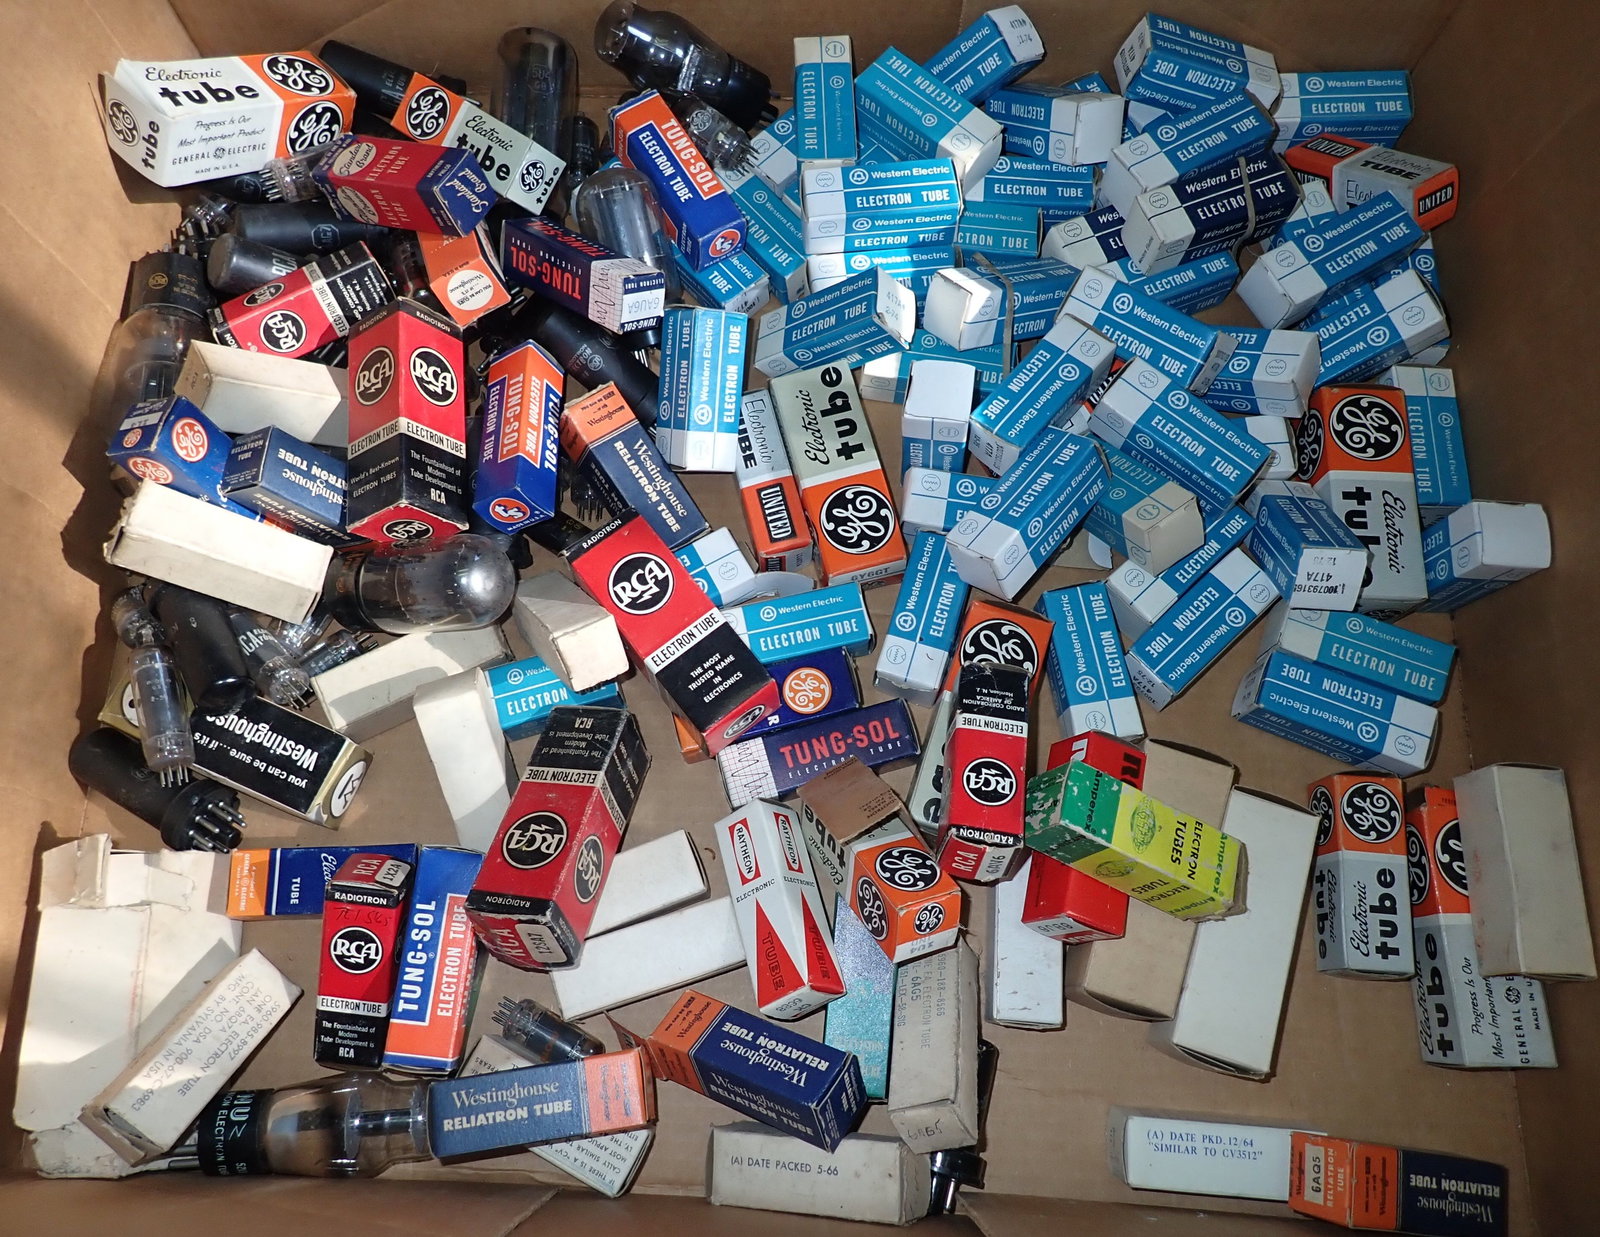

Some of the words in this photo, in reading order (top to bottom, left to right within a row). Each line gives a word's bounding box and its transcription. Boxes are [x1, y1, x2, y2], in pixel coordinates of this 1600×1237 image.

[1157, 20, 1181, 34] TUBE
[1190, 30, 1236, 51] ELECTRON
[931, 46, 960, 75] Western
[960, 26, 991, 53] Electric
[145, 67, 222, 81] Electronic
[886, 56, 912, 78] TUBE
[977, 54, 1003, 77] TUBE
[1152, 60, 1178, 82] TUBE
[159, 82, 259, 107] tube
[803, 71, 815, 119] ELECTRON
[914, 77, 963, 113] ELECTRON
[1185, 69, 1237, 92] ELECTRON
[1326, 79, 1364, 88] Western
[1366, 78, 1403, 87] Electric
[990, 100, 1006, 114] TUBE
[1011, 104, 1045, 120] ELECTRON
[1176, 109, 1208, 130] Western
[1208, 94, 1245, 116] Electric
[1311, 102, 1365, 114] ELECTRON
[1376, 101, 1403, 112] TUBE
[142, 120, 160, 169] tube
[178, 138, 197, 148] Most
[198, 131, 235, 142] Important
[237, 127, 265, 137] Product
[466, 115, 513, 151] Electronic
[805, 127, 818, 151] TUBE
[1307, 138, 1355, 157] UNITED
[172, 152, 210, 165] GENERAL
[228, 143, 266, 155] ELECTRIC
[366, 146, 402, 181] ELECTRON
[388, 156, 409, 174] TUBE
[661, 119, 714, 192] TUNG-SOL
[458, 168, 487, 192] Brand
[638, 131, 676, 176] ELECTRON
[670, 176, 693, 202] TUBE
[871, 171, 911, 179] Western
[913, 166, 950, 175] Electric
[446, 179, 488, 212] Standard
[536, 167, 560, 204] tube
[1419, 182, 1453, 214] UNITED
[1322, 219, 1359, 240] Western
[1359, 200, 1393, 221] Electric
[527, 221, 607, 257] TUNG-SOL
[1325, 241, 1378, 275] ELECTRON
[1381, 222, 1410, 244] TUBE
[510, 245, 582, 300] TUNG-SOL
[708, 271, 732, 294] TUBE
[267, 312, 298, 350] RCA
[416, 311, 451, 333] RADIOTRON
[1133, 305, 1170, 329] Western
[1169, 323, 1206, 348] Electric
[1324, 342, 1366, 367] Western
[357, 358, 392, 393] RCA
[413, 358, 455, 394] RCA
[1008, 350, 1051, 393] ELECTRON
[983, 396, 1009, 420] TUBE
[1034, 380, 1065, 410] Western
[503, 373, 523, 455] TUNG-SOL
[799, 389, 830, 465] Electronic
[820, 366, 866, 461] tube
[1008, 409, 1039, 438] Electric
[1188, 404, 1226, 435] Western
[1225, 433, 1261, 460] Electric
[1408, 405, 1427, 464] ELECTRON
[999, 462, 1027, 493] Western
[1026, 432, 1056, 464] Electric
[1151, 415, 1206, 458] ELECTRON
[1211, 456, 1241, 481] TUBE
[614, 440, 660, 503] RELIATRON
[656, 502, 681, 533] TUBE
[632, 438, 687, 517] Westinghouse
[1417, 469, 1432, 494] TUBE
[430, 488, 446, 504] RCA
[760, 485, 793, 539] UNITED
[582, 518, 622, 549] RADIOTRON
[1382, 490, 1407, 574] Electronic
[613, 560, 669, 604] RCA
[1307, 572, 1332, 582] 417A
[687, 669, 715, 692] TRUSTED
[715, 654, 736, 671] NAME
[690, 664, 703, 678] THE
[702, 652, 721, 668] MOST
[1281, 663, 1311, 685] TUBE
[1330, 643, 1396, 677] ELECTRON
[1404, 668, 1436, 691] TUBE
[703, 671, 743, 703] ELECTRONICS
[1322, 676, 1383, 710] ELECTRON
[574, 717, 593, 728] RCA
[961, 717, 983, 727] TUBE
[984, 720, 1024, 734] ELECTRON
[194, 732, 210, 744] it's
[565, 740, 587, 748] Modern
[779, 717, 901, 769] TUNG-SOL
[254, 759, 267, 771] be
[268, 766, 287, 779] can
[288, 773, 308, 788] you
[966, 768, 1014, 795] RCA
[509, 823, 565, 854] RCA
[736, 826, 754, 875] RAYTHEON
[780, 818, 798, 865] RAYTHEON
[959, 828, 1014, 845] RADIOTRON
[1170, 820, 1187, 866] TUBES
[352, 860, 382, 875] RCA
[952, 850, 980, 873] RCA
[1212, 833, 1229, 893] Amperex
[290, 877, 301, 905] TUBE
[334, 892, 387, 905] RADIOTRON
[485, 895, 531, 907] RADIOTRON
[1314, 870, 1328, 960] tube
[1349, 881, 1370, 958] Electronic
[1370, 867, 1400, 960] tube
[335, 939, 379, 963] RCA
[398, 900, 436, 1012] TUNG-SOL
[227, 973, 248, 993] MFG
[246, 988, 263, 1007] JAN
[1424, 933, 1454, 1058] tube
[216, 994, 227, 1007] BY
[254, 994, 273, 1014] ONE
[173, 1007, 216, 1047] SYLVANIA
[218, 1006, 245, 1034] 6BQ7A
[227, 1001, 283, 1062] 5960-985-8997
[721, 1022, 757, 1041] TUBE
[194, 1026, 214, 1046] DSA
[1492, 1031, 1506, 1059] Most
[1512, 1007, 1529, 1064] GENERAL
[165, 1047, 176, 1060] IN
[201, 1031, 241, 1073] ELECTRON
[339, 1047, 354, 1058] RCA
[720, 1039, 808, 1087] Westinghouse
[756, 1035, 830, 1071] RELIATRON
[142, 1059, 162, 1080] USA
[177, 1076, 201, 1097] TUBE
[451, 1080, 560, 1109] Westinghouse
[710, 1072, 800, 1120] Westinghouse
[443, 1108, 529, 1132] RELIATRON
[533, 1099, 572, 1115] TUBE
[710, 1084, 777, 1120] RELIATRON
[781, 1116, 814, 1137] TUBE
[1147, 1129, 1164, 1141] (A)
[1170, 1132, 1197, 1143] DATE
[1148, 1142, 1197, 1155] "SIMILAR
[1204, 1147, 1217, 1157] TO
[730, 1155, 744, 1167] (A)
[747, 1157, 771, 1170] DATE
[775, 1160, 812, 1173] PACKED
[816, 1164, 839, 1176] 5-66
[1311, 1156, 1321, 1194] 6AQ5
[1409, 1174, 1437, 1189] TUBE
[1441, 1179, 1500, 1198] RELIATRON
